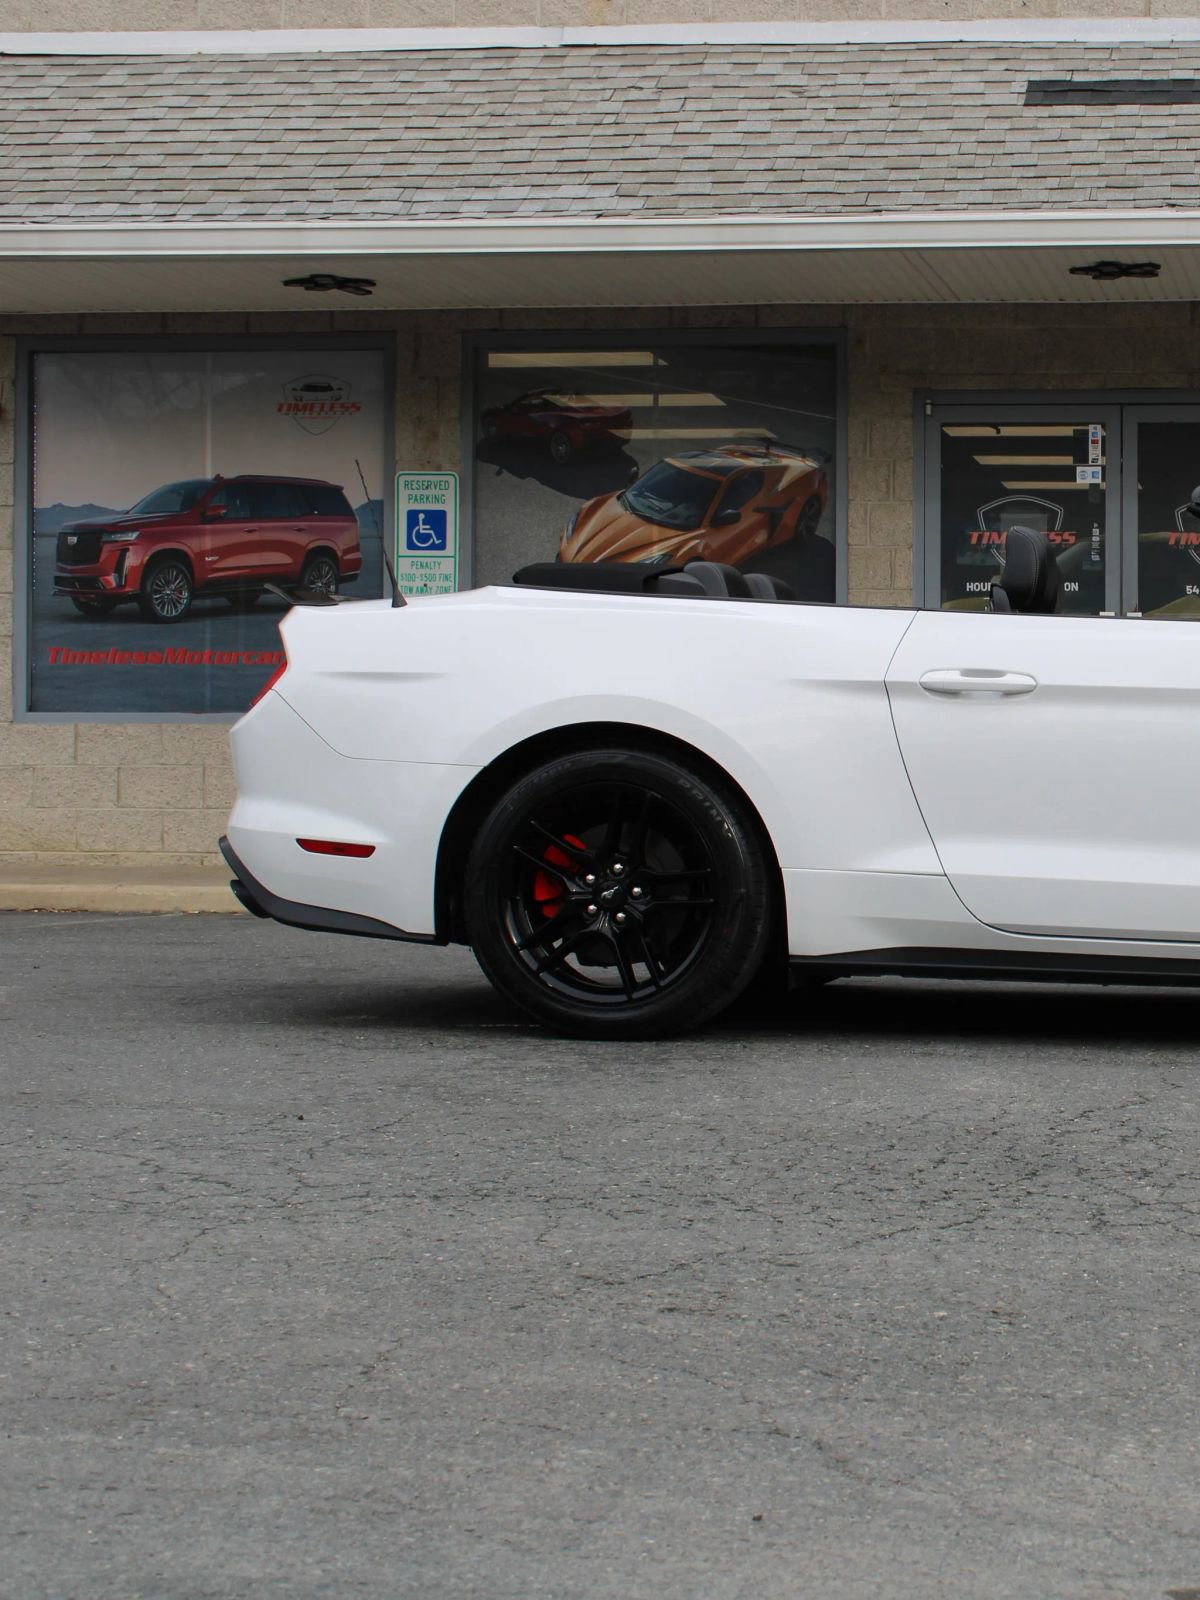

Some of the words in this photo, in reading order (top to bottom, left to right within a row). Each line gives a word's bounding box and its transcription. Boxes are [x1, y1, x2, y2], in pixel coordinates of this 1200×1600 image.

[277, 402, 362, 413] TIMELESS
[404, 480, 450, 491] RESERVED
[407, 494, 446, 505] PARKING
[968, 531, 1077, 545] TIMSS
[410, 560, 442, 570] PENALTY
[438, 572, 453, 582] FINE
[400, 585, 414, 594] TOW
[416, 585, 433, 594] AWAY
[435, 585, 453, 594] ZONE
